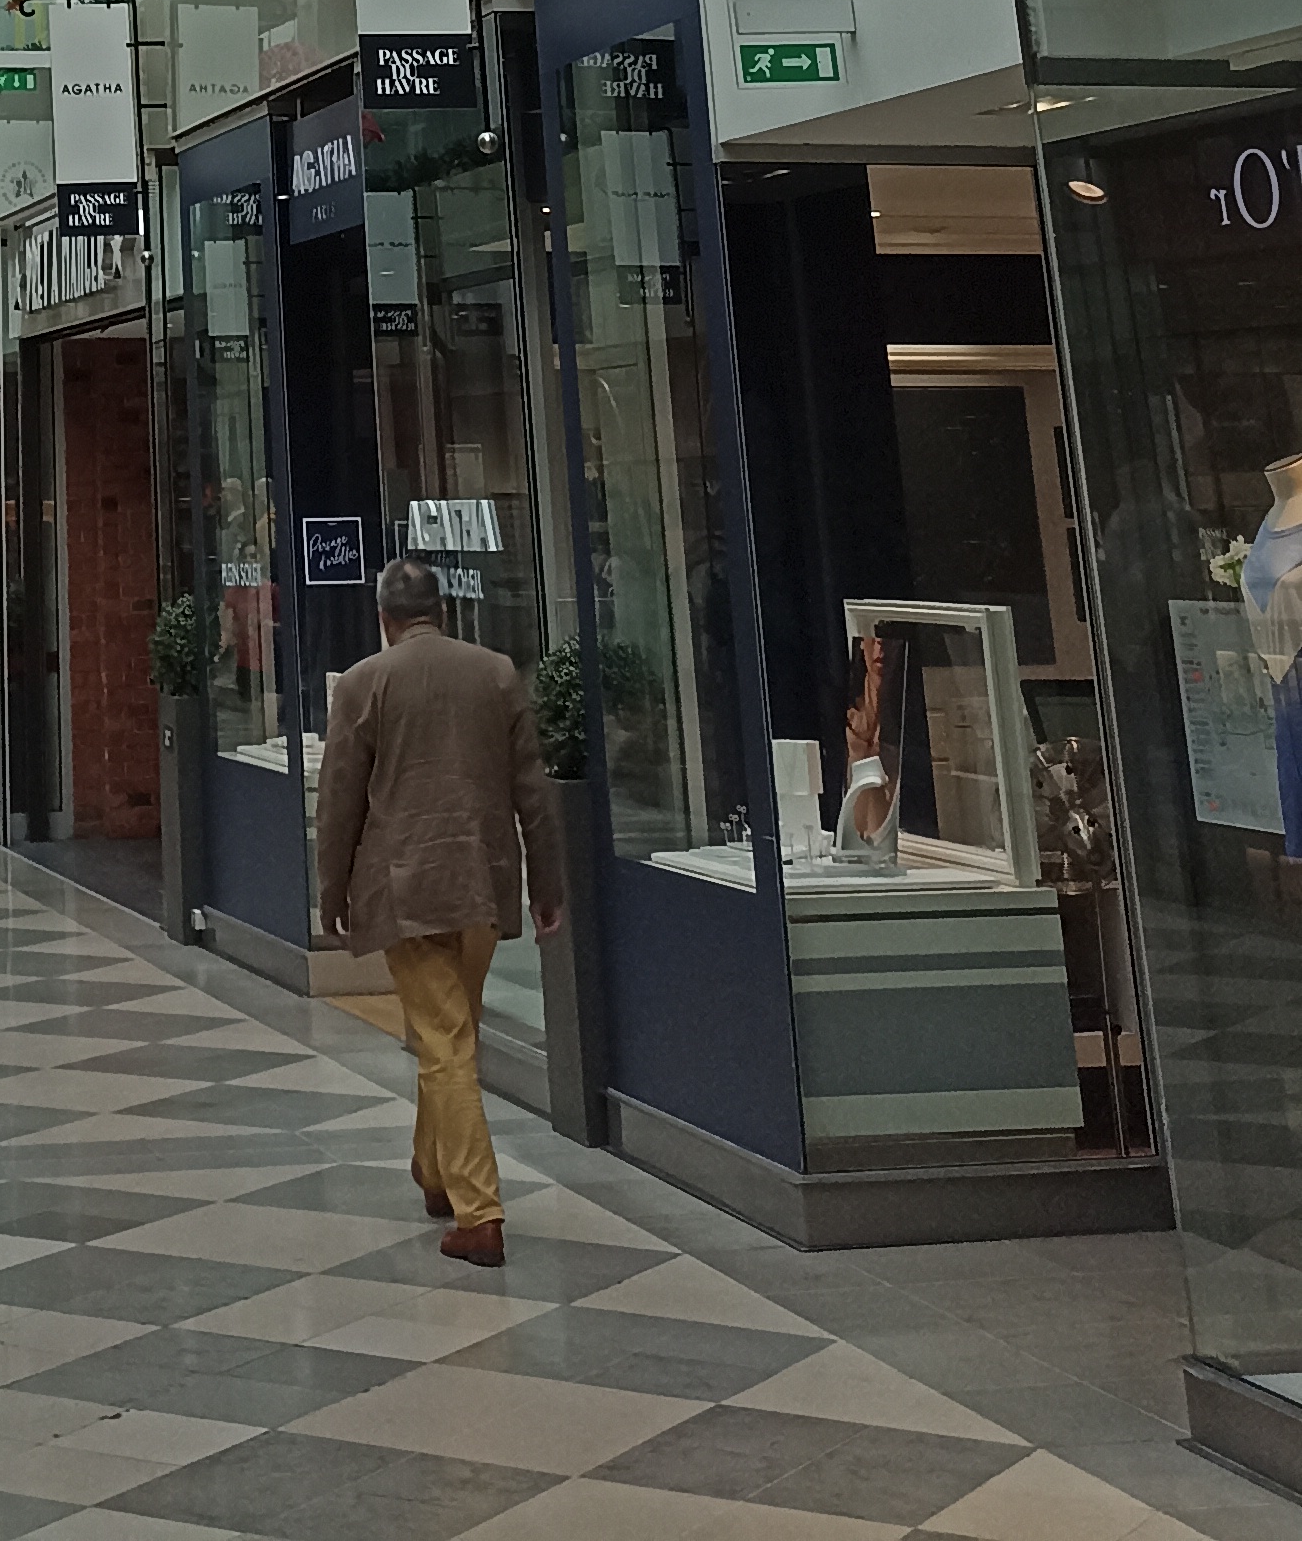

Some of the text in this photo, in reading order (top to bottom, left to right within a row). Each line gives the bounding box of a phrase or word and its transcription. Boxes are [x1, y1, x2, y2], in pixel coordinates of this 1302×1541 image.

[378, 48, 460, 66] PASSAGE
[390, 63, 418, 80] DU
[61, 82, 123, 96] AGATHA
[377, 77, 441, 95] HAVRE
[292, 134, 357, 197] AGATHA
[69, 192, 128, 206] PASSAGE
[68, 213, 114, 226] HAVRE
